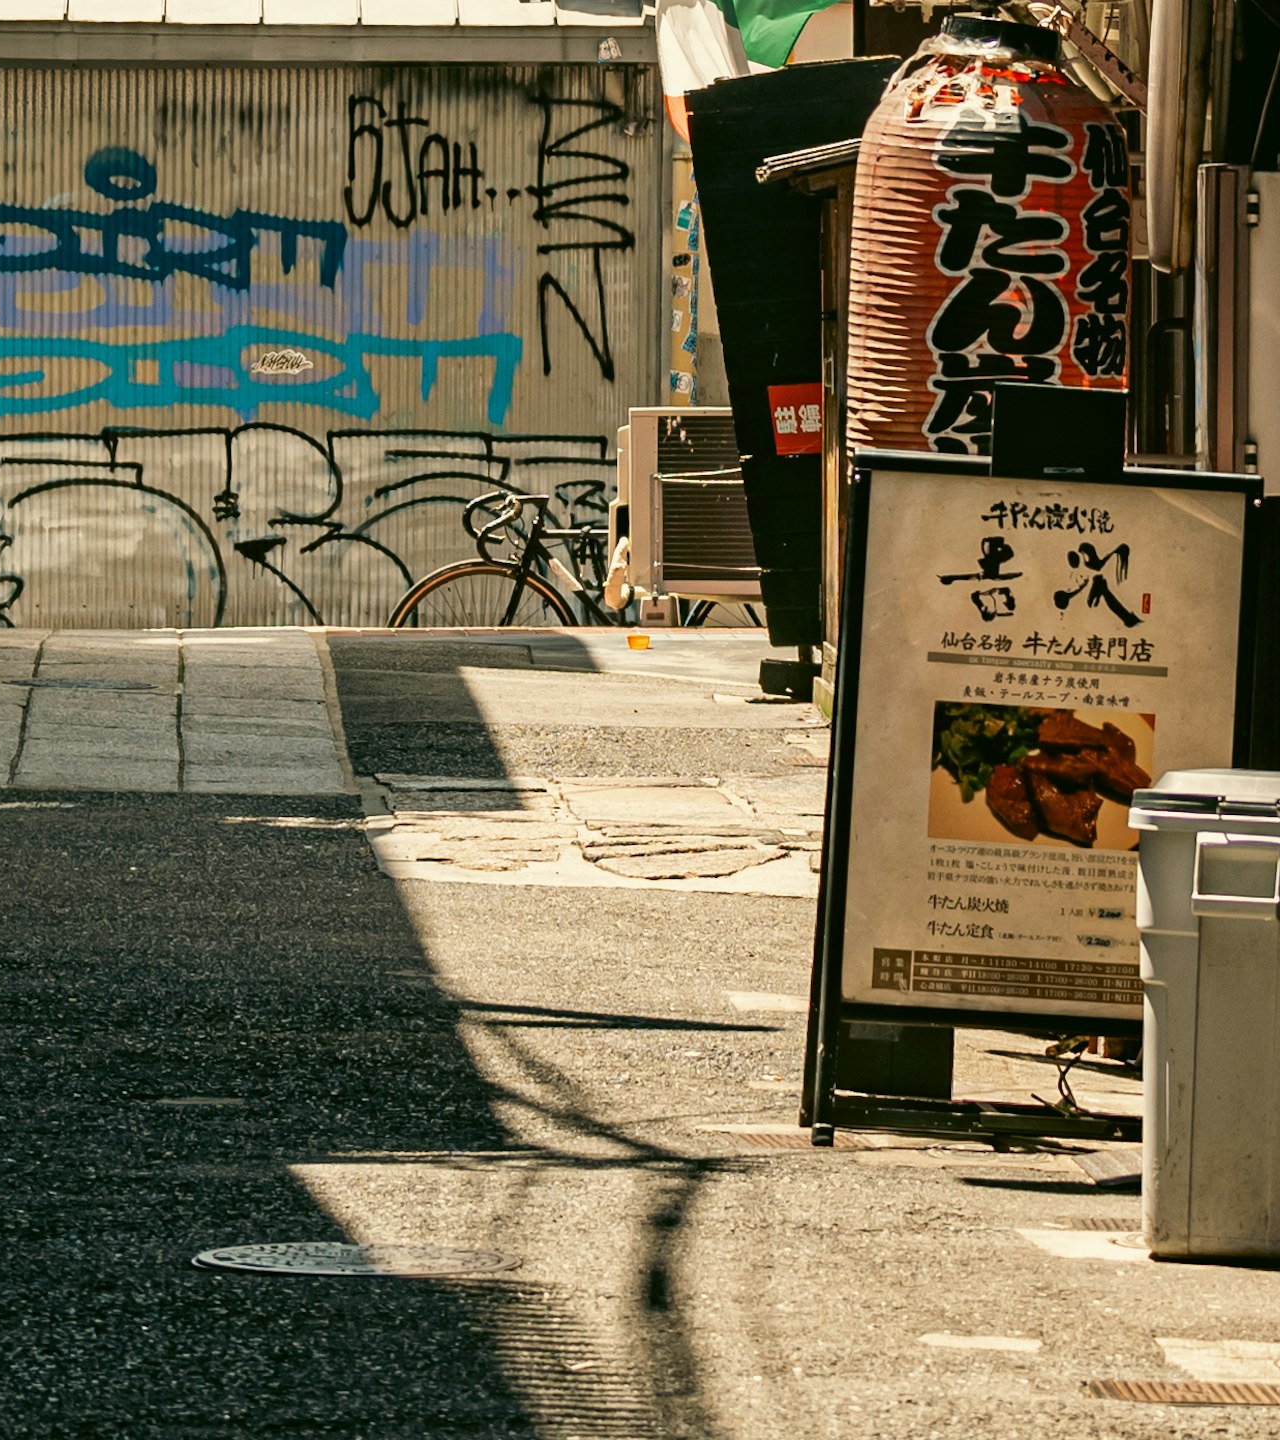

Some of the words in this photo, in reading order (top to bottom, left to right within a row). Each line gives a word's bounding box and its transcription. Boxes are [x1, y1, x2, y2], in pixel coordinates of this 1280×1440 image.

[1075, 121, 1130, 378] 仙台名物
[925, 110, 1077, 454] 牛たん炭
[941, 630, 1013, 652] 仙台名物
[1021, 630, 1156, 663] 牛たん専門店
[927, 893, 1010, 914] 牛たん炭火焼
[926, 919, 995, 940] 牛たん定食
